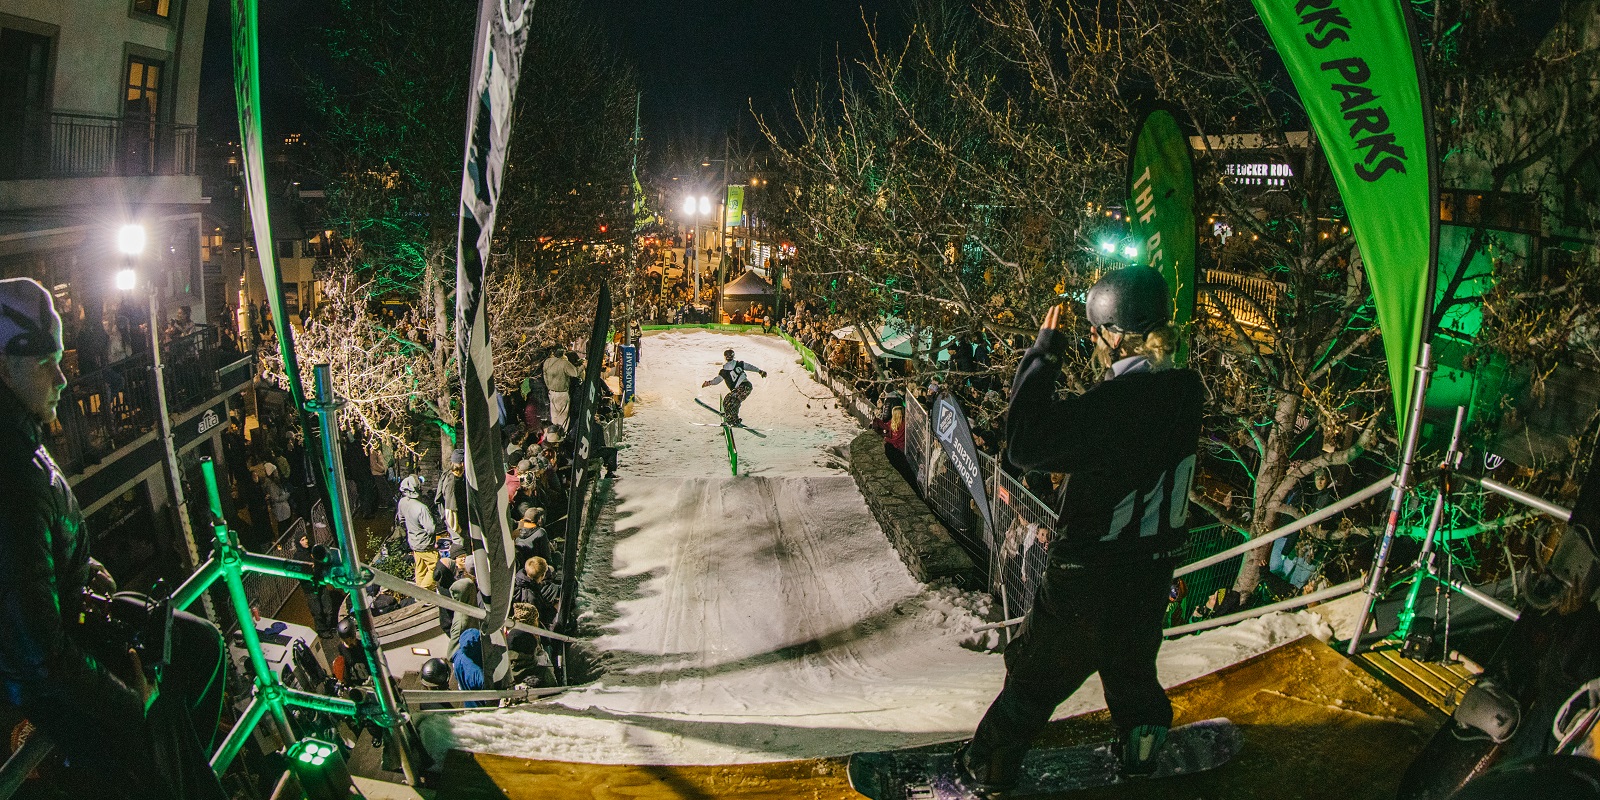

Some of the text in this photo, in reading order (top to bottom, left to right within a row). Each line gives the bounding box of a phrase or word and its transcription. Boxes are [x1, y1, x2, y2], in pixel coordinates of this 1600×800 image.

[1320, 57, 1408, 182] PARKS
[1236, 163, 1268, 176] LOCKER
[1267, 178, 1286, 186] BAR
